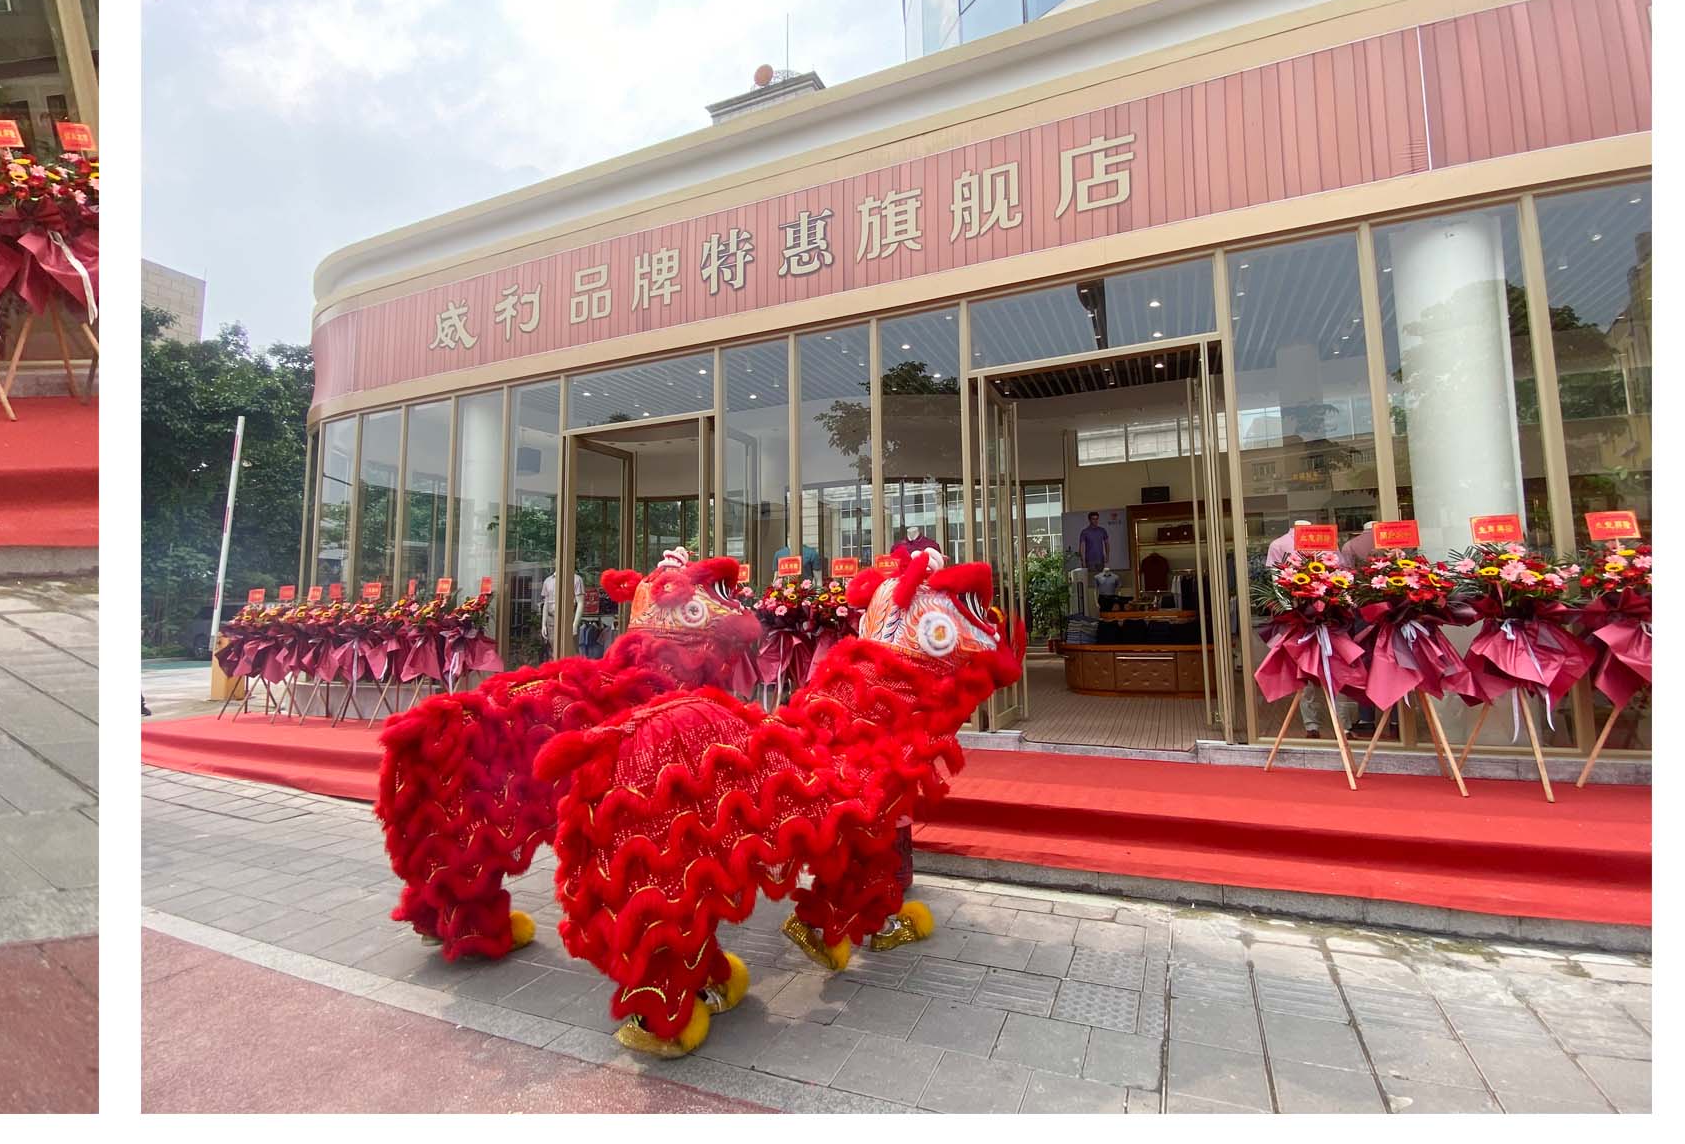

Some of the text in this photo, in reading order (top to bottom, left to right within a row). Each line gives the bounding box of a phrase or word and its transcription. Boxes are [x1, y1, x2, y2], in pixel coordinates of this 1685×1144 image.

[428, 134, 1136, 350] 威利品牌特惠旗舰店
